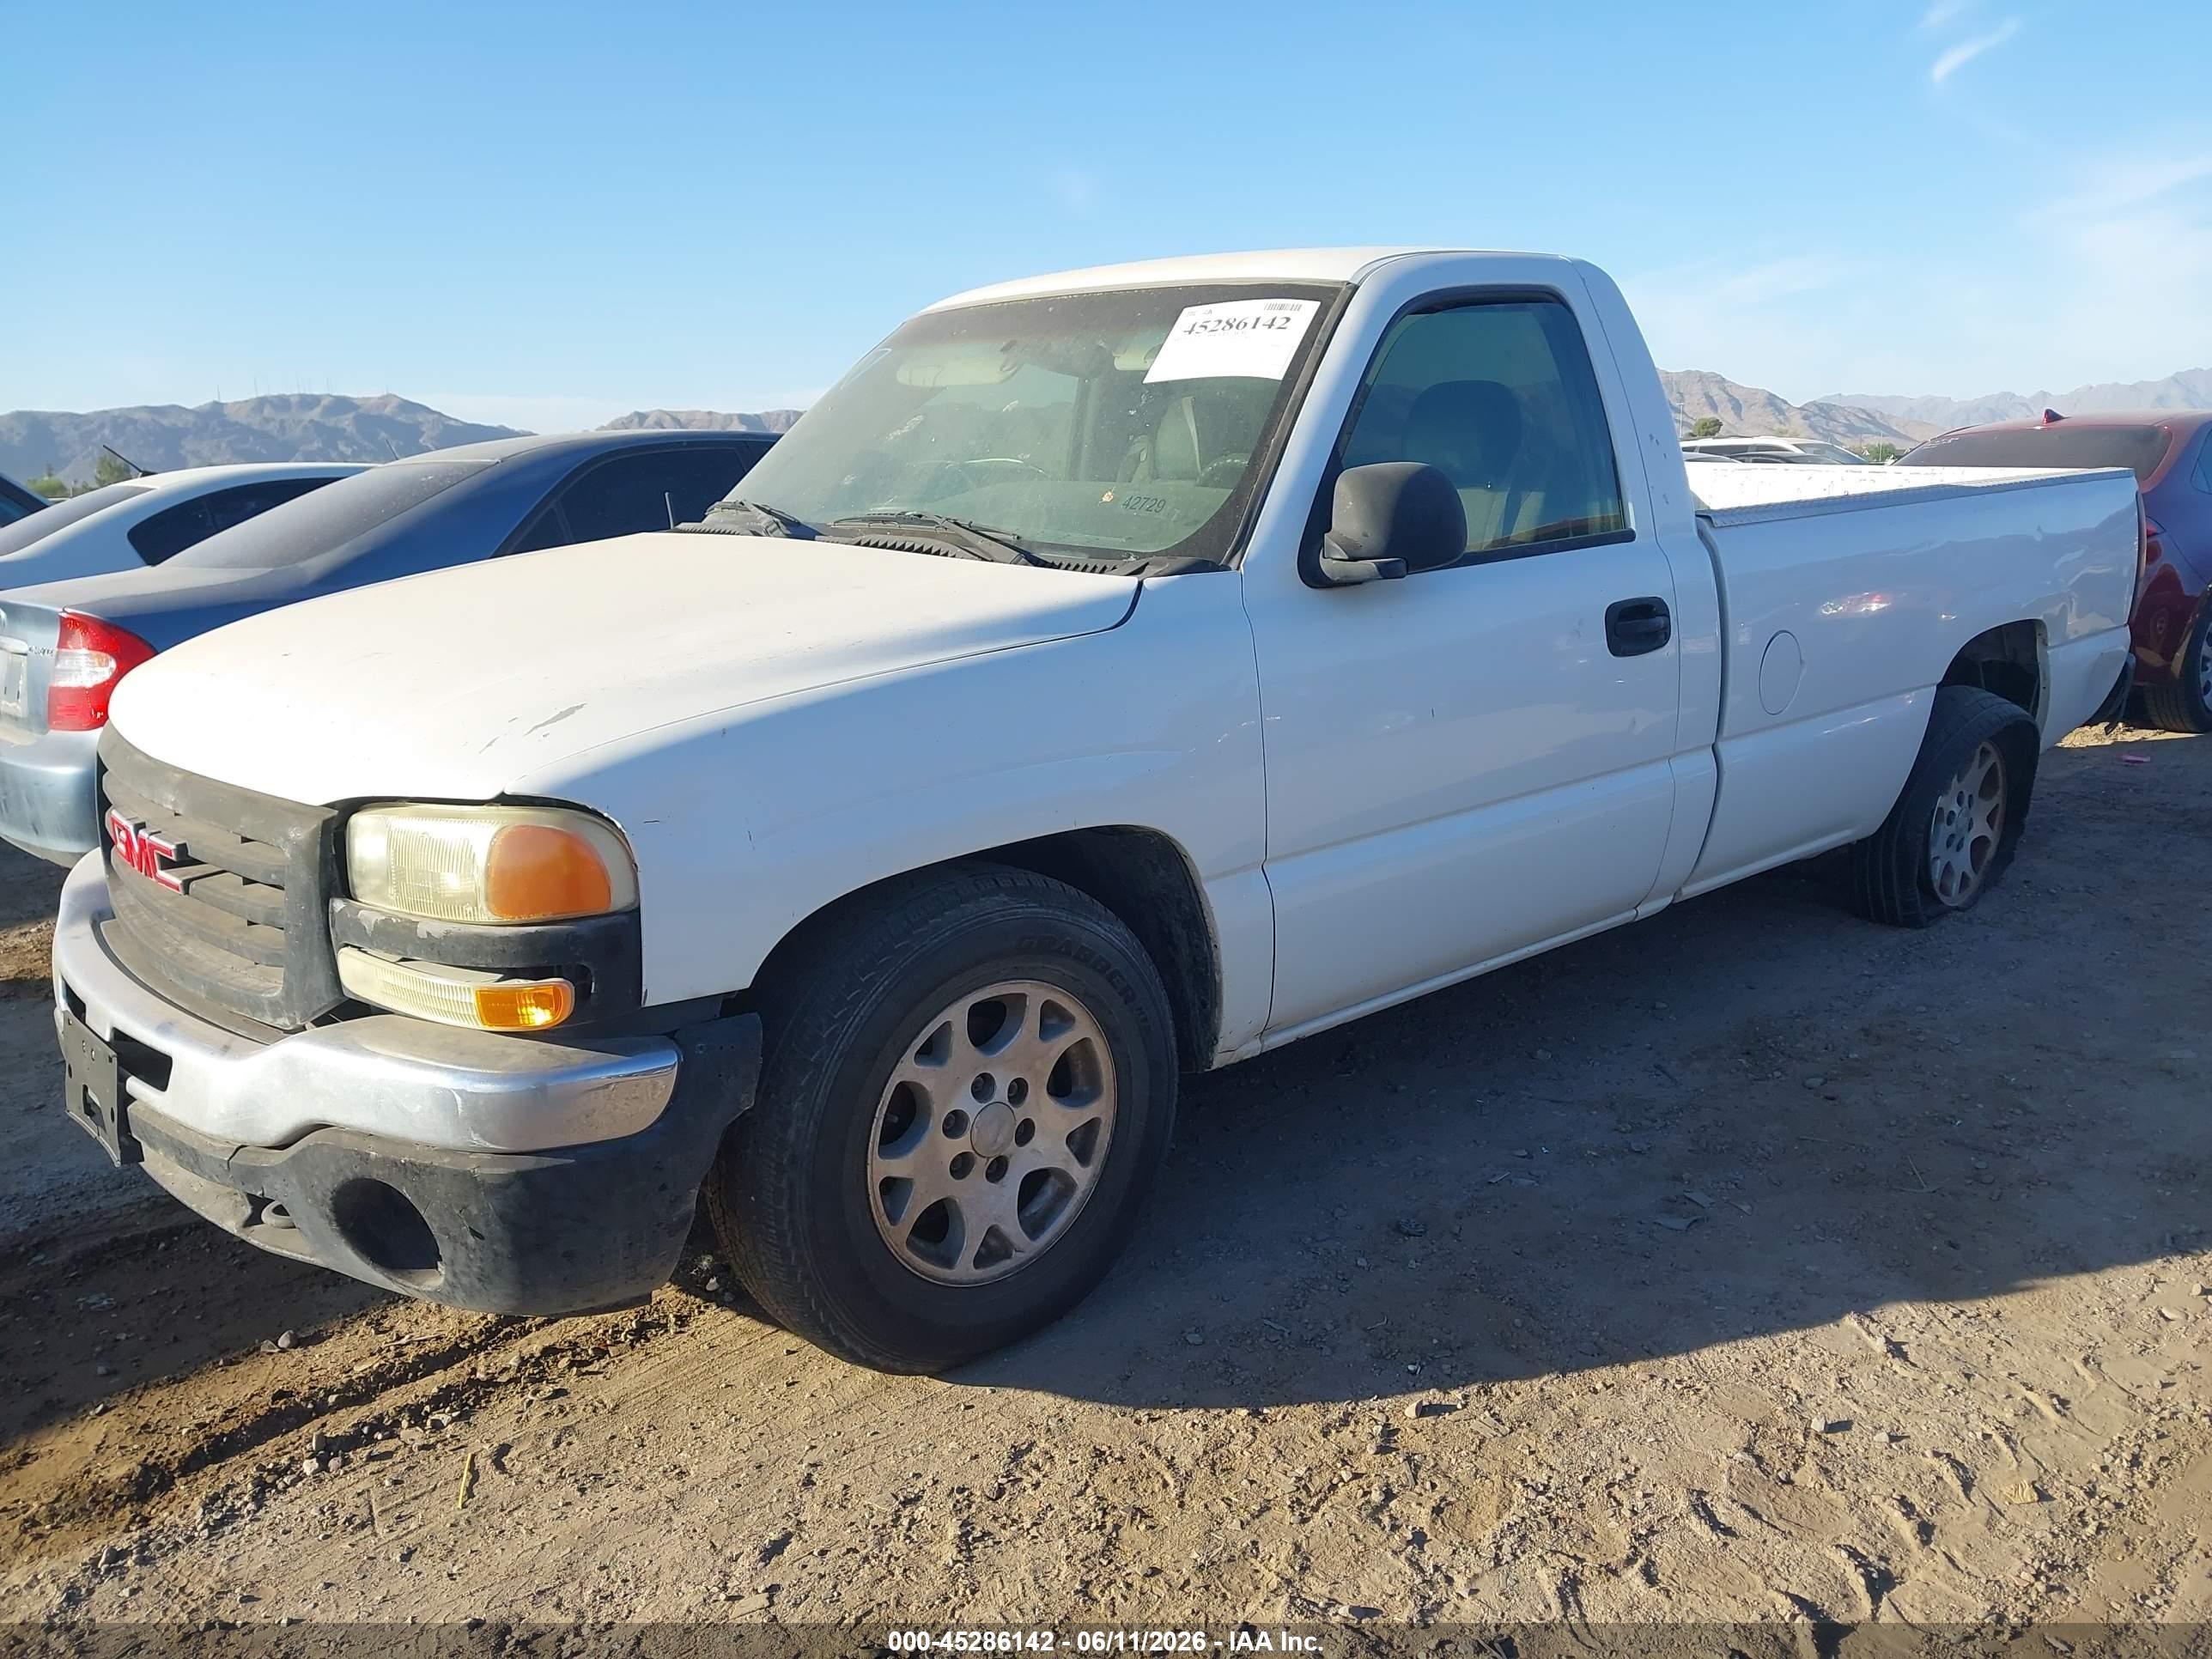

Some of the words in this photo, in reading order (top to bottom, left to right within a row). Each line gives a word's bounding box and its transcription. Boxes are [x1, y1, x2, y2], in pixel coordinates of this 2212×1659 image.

[1182, 315, 1292, 336] 45286142
[1121, 495, 1168, 514] 42729
[110, 809, 187, 896] GMC
[1014, 933, 1137, 1006] GRABBER
